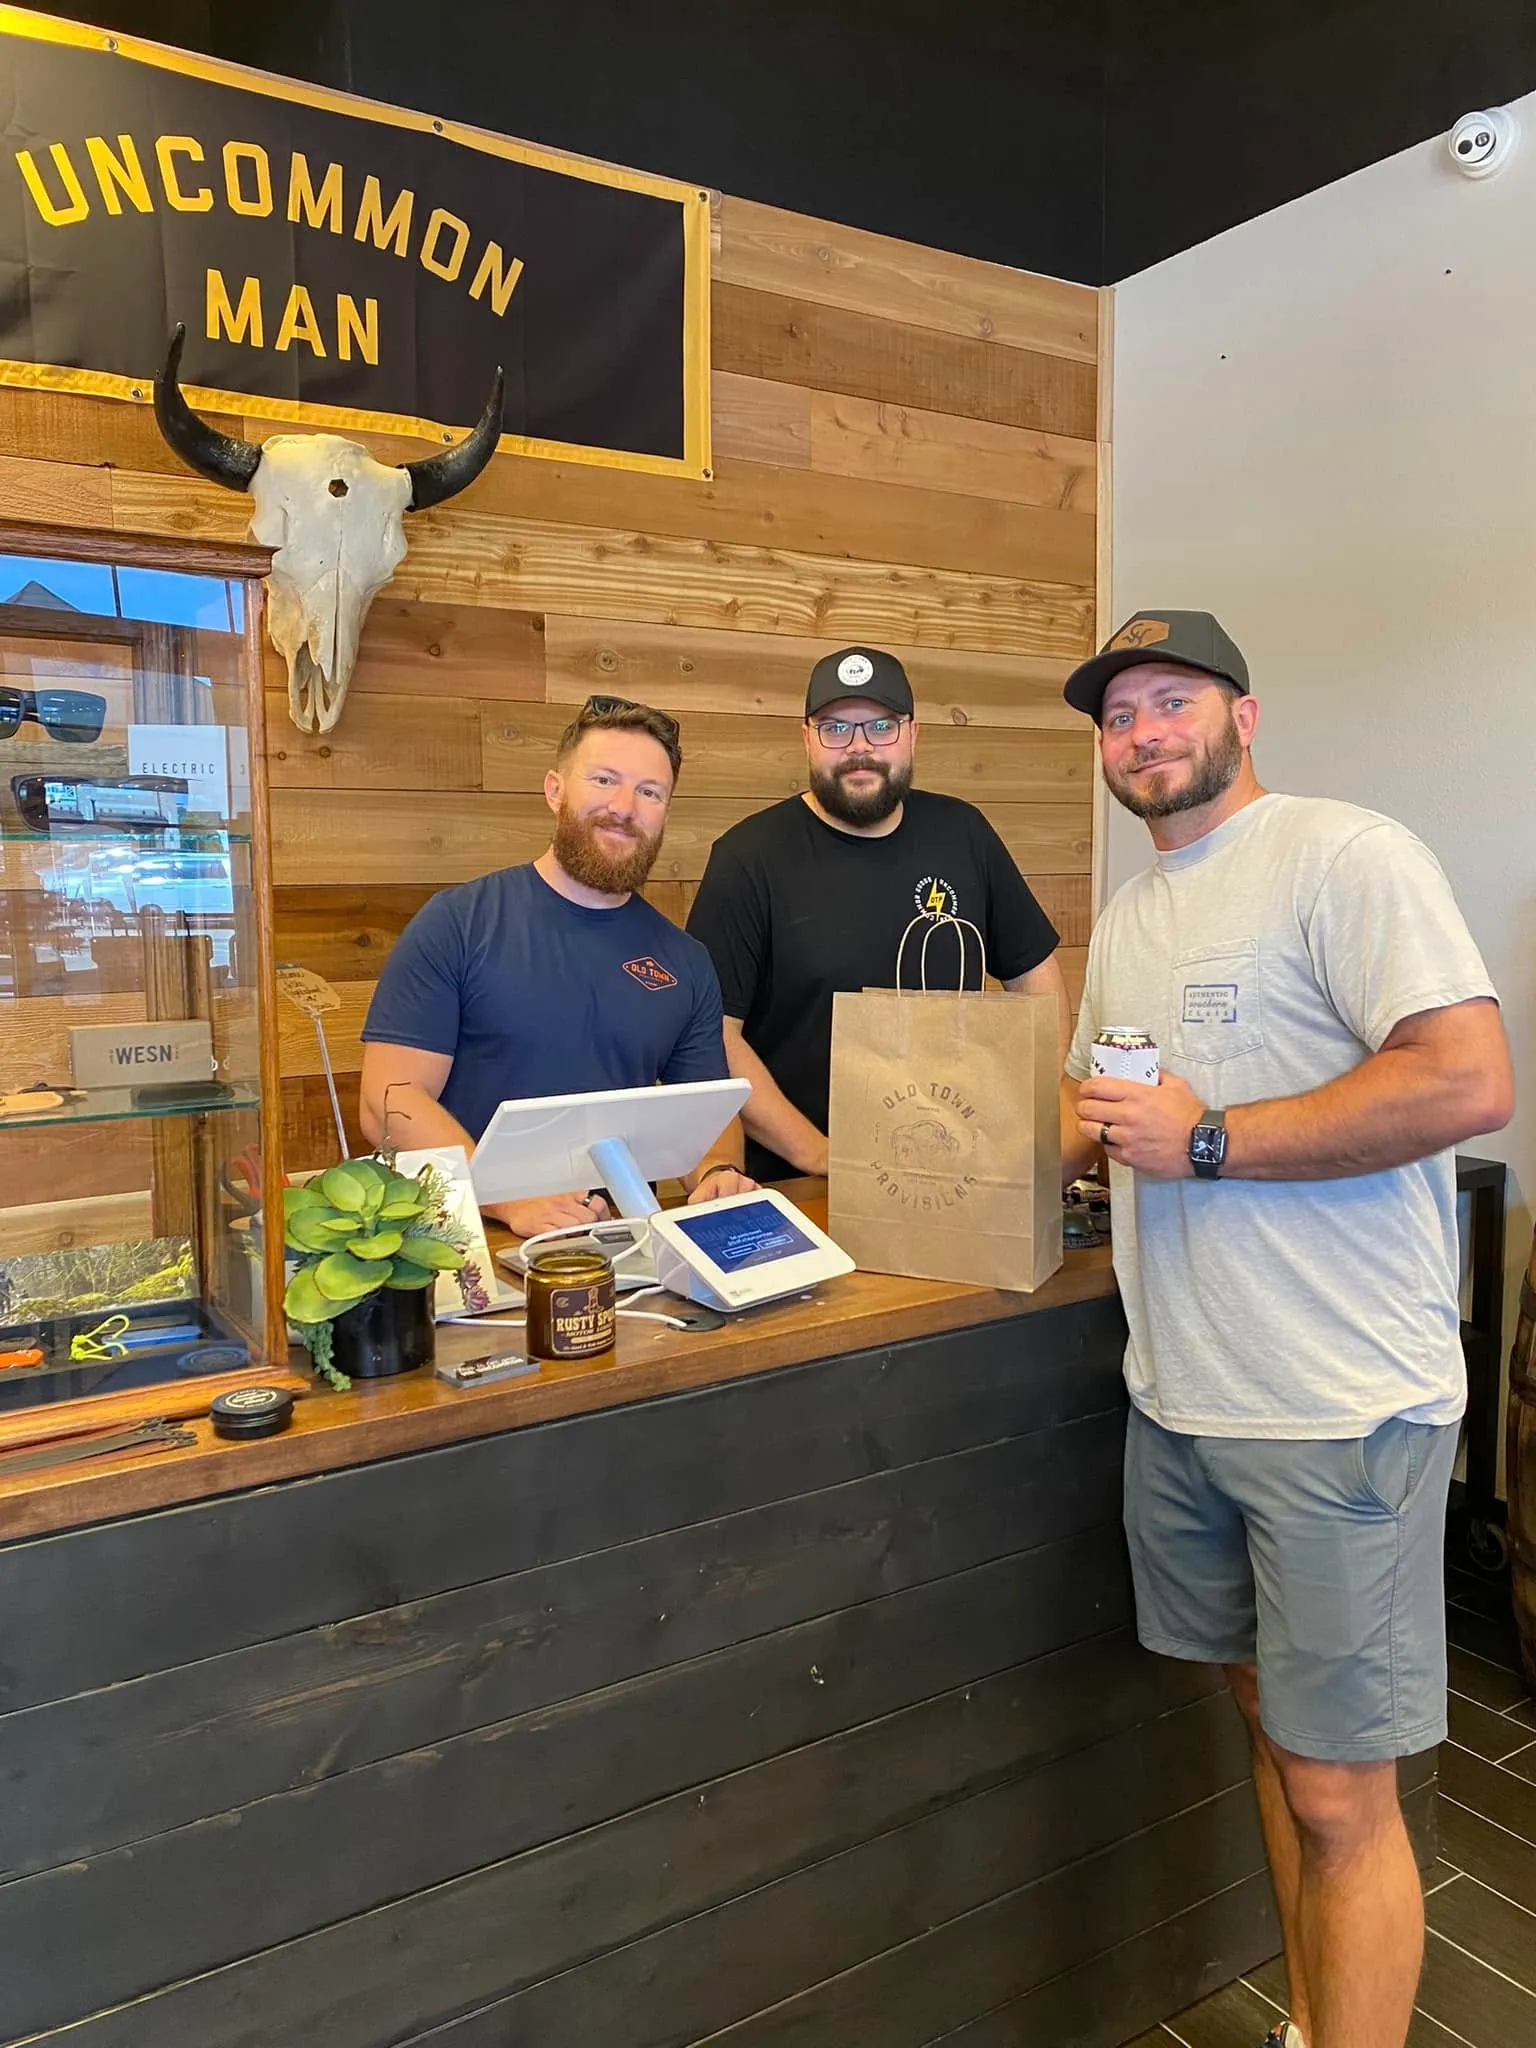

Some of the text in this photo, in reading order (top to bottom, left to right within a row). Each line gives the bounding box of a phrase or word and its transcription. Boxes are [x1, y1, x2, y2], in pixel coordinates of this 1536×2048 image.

[15, 133, 525, 317] UNCOMMON
[205, 267, 379, 366] MAN
[141, 762, 217, 775] ELECTRIC
[631, 963, 670, 982] OLD TOWN
[115, 1044, 172, 1065] WESN
[882, 1082, 976, 1120] OLD TOWN
[556, 1314, 595, 1332] RUSTY
